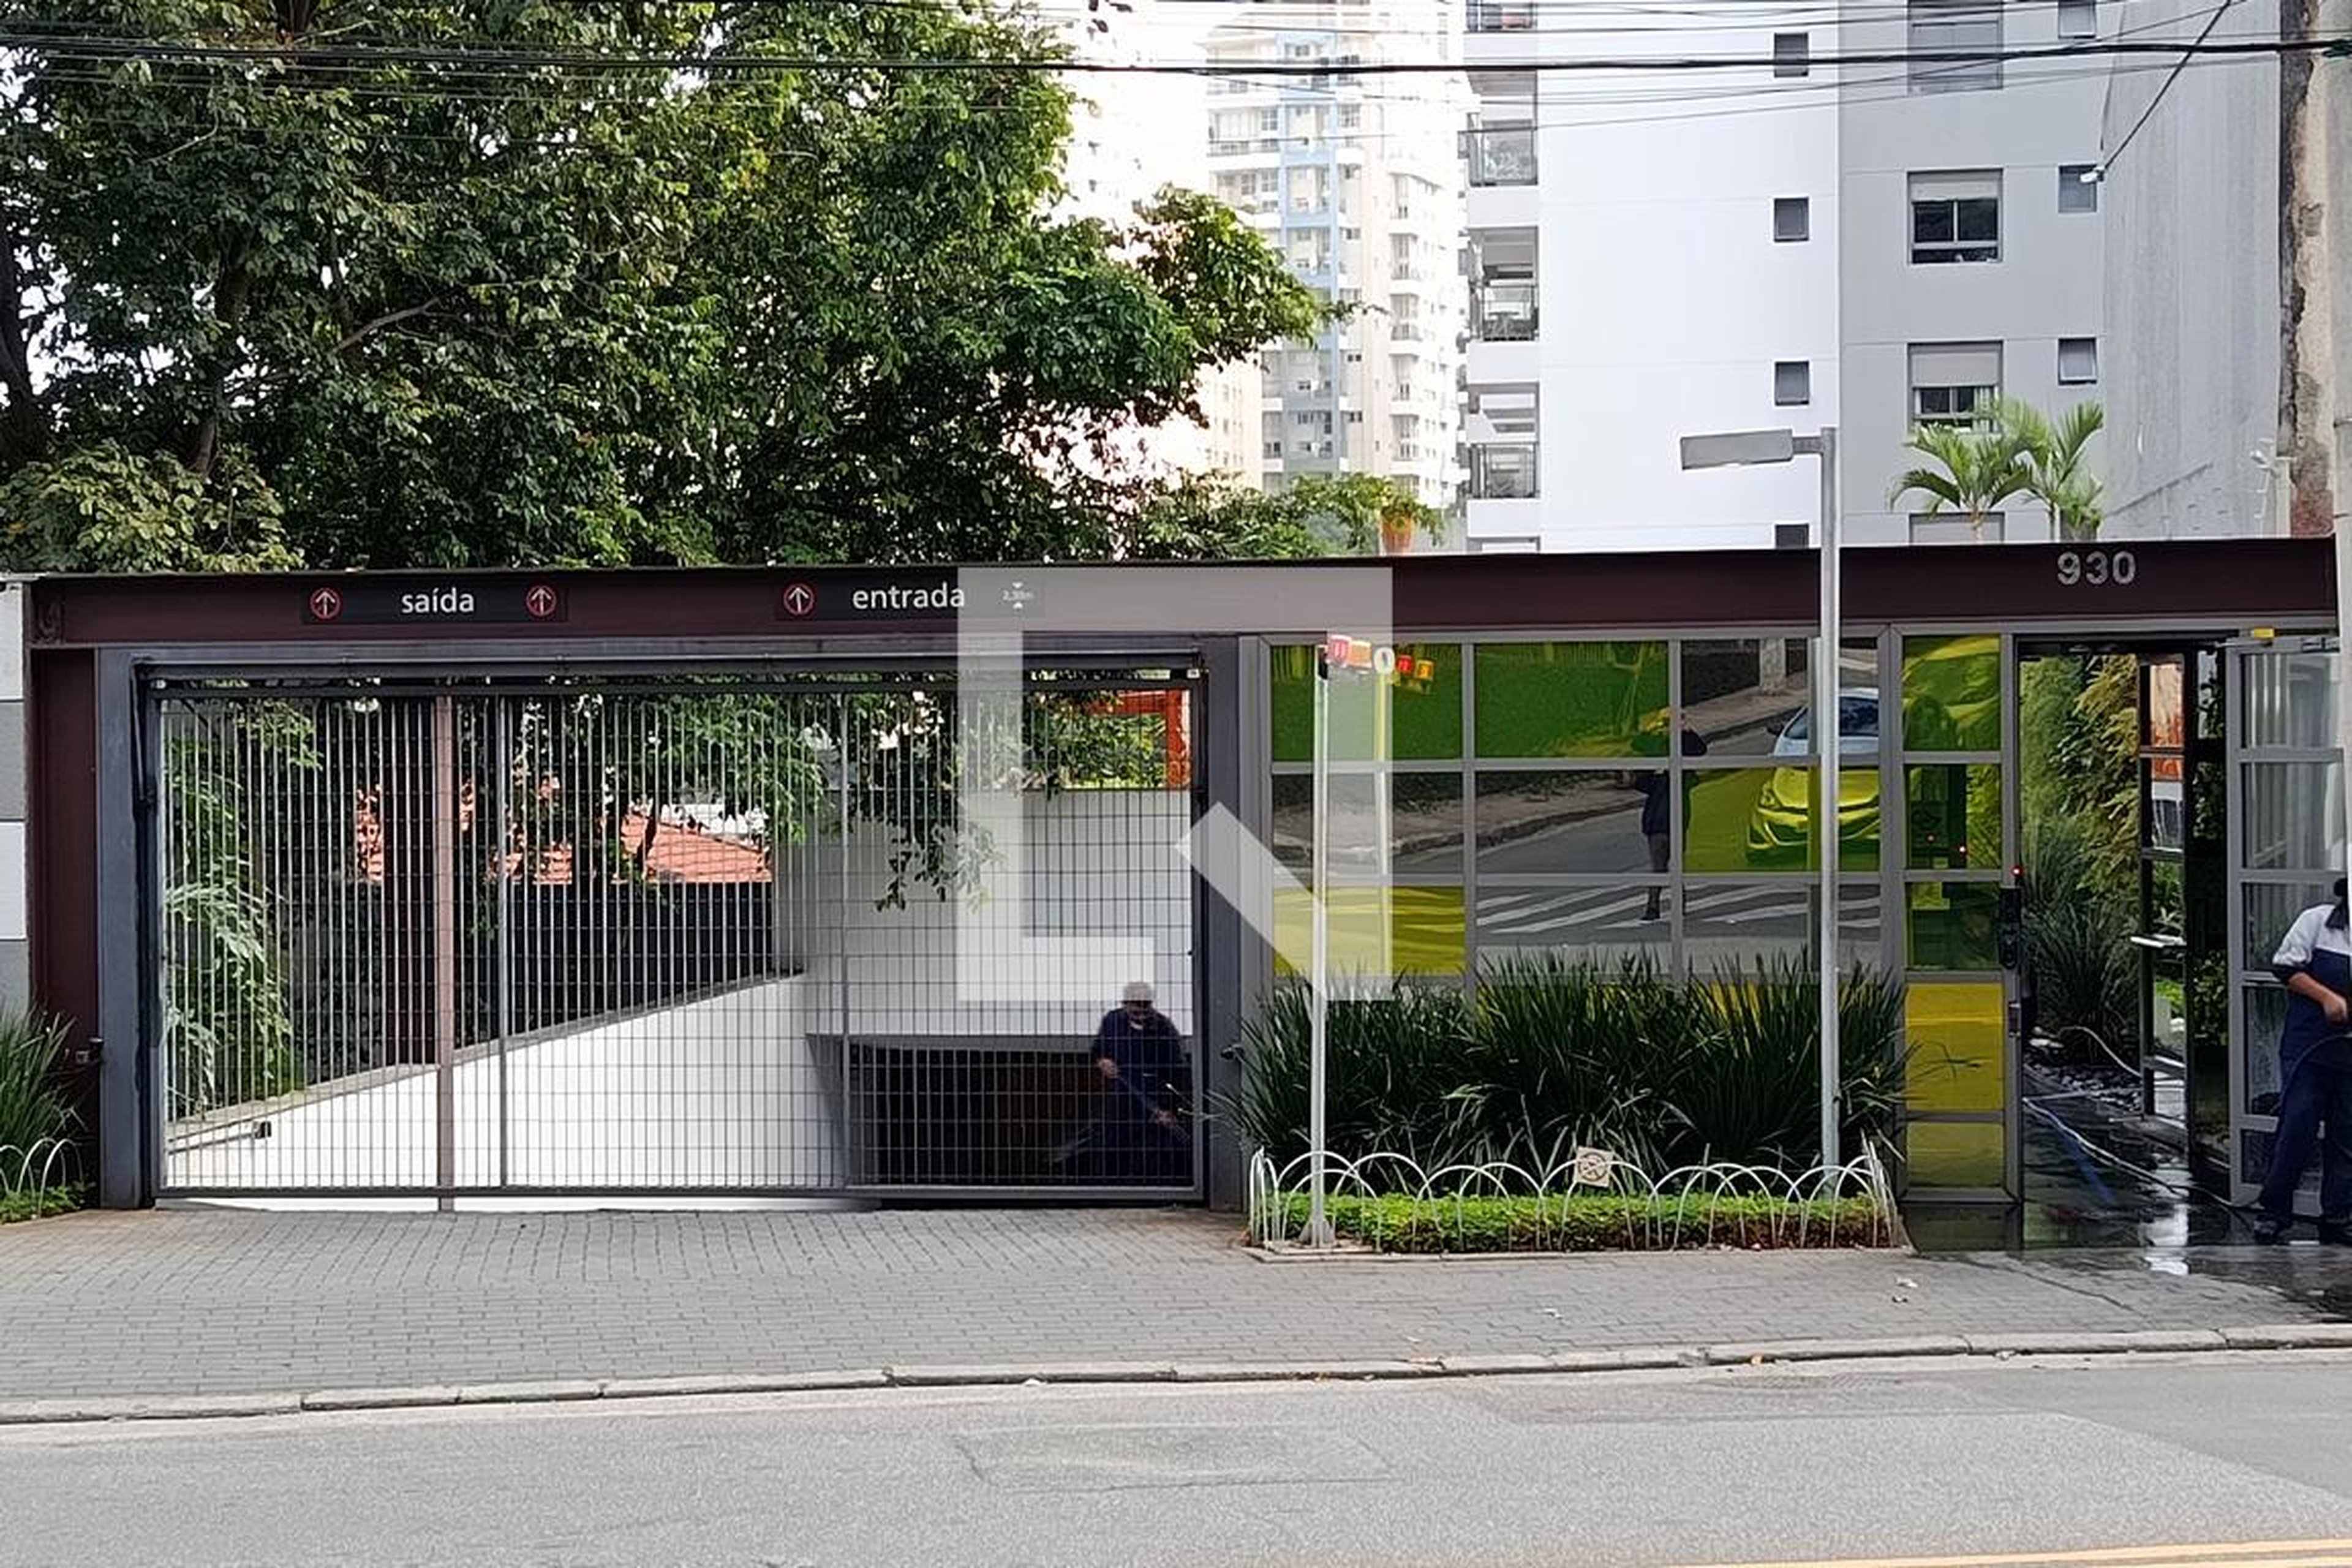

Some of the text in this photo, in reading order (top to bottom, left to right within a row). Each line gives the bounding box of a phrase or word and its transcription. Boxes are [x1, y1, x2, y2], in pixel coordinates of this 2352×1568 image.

[2057, 551, 2136, 585] 930
[401, 587, 475, 613] saída
[852, 582, 965, 609] entrada
